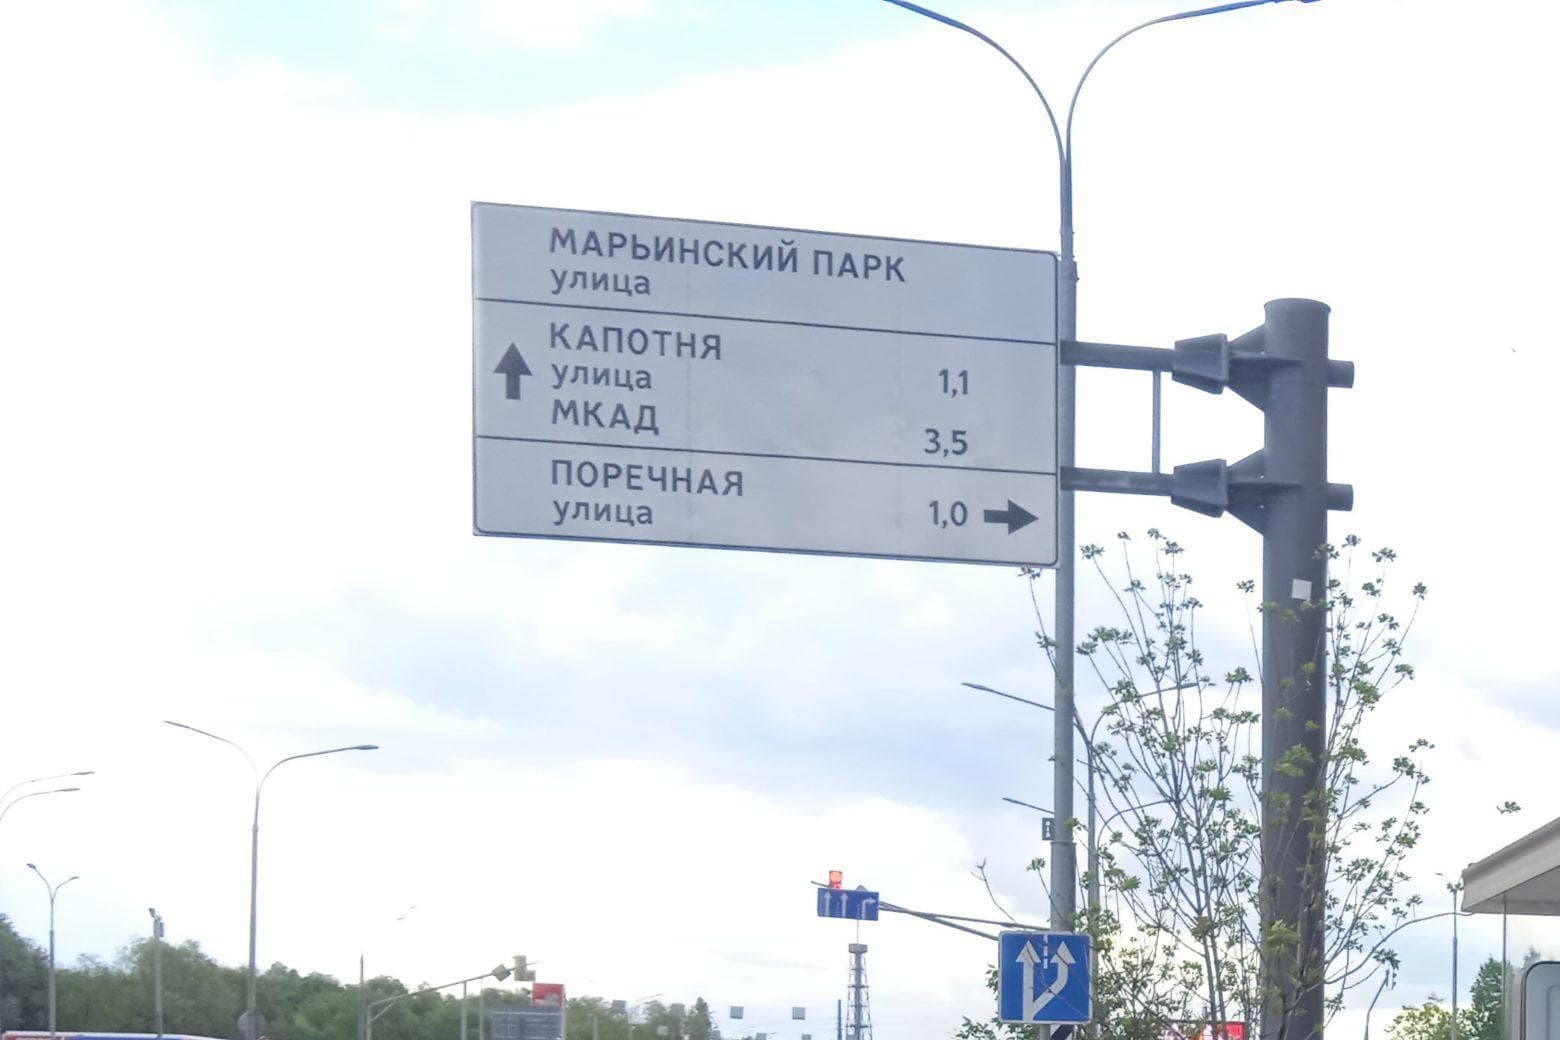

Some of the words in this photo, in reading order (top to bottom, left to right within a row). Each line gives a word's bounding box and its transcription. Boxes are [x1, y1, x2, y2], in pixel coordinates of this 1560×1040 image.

[549, 227, 798, 273] МАРЬИНСКИЙ
[813, 250, 906, 283] ПАРК
[550, 267, 651, 297] улица
[550, 322, 722, 361] КАПОТНЯ
[551, 363, 652, 391] улица
[938, 368, 969, 397] 1,1
[552, 400, 659, 436] МКАД
[924, 428, 968, 457] 3,5
[552, 460, 744, 497] ПОРЕЧНАЯ
[553, 500, 654, 527] улица
[928, 500, 968, 528] 1,0
